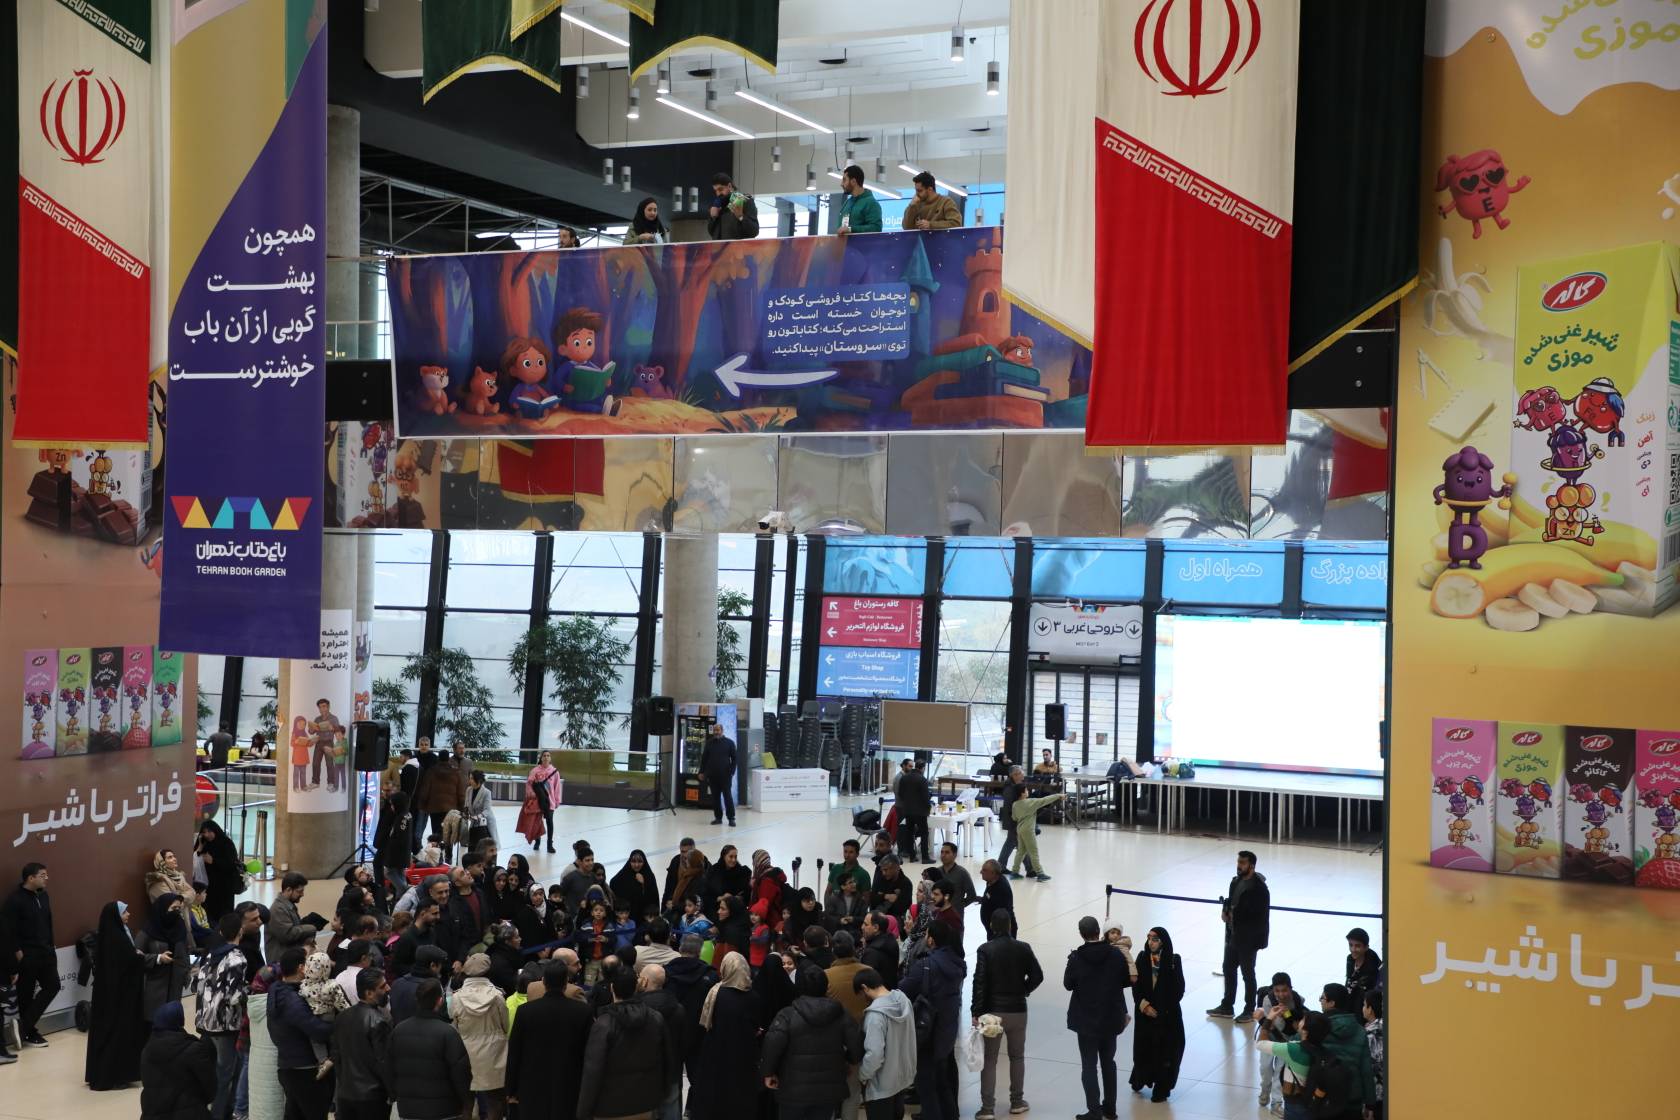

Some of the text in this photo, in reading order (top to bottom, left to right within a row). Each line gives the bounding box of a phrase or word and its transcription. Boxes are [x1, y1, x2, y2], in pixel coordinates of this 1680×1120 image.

[244, 224, 316, 256] همچون
[207, 266, 315, 294] بهشت
[775, 294, 805, 307] کودک
[805, 292, 841, 307] فروشی
[842, 291, 872, 306] کتاب
[1550, 276, 1598, 308] کاله
[767, 300, 774, 308] و
[767, 306, 907, 323] نوجوان خسته است داره
[184, 309, 220, 343] باب
[272, 305, 316, 344] گویی
[767, 330, 777, 338] رو
[859, 321, 906, 334] استراحت
[887, 340, 907, 352] توی
[1524, 323, 1619, 365] شیر غنی شده
[169, 354, 315, 388] خوشترست
[1547, 349, 1593, 372] موزی
[196, 540, 286, 563] باغ کتاب تهران
[196, 565, 228, 576] TEHRAN
[254, 566, 287, 577] GARDEN
[1179, 557, 1263, 582] همراه اول
[1310, 559, 1354, 585] بزرگ
[1063, 622, 1086, 634] غربی
[1087, 623, 1124, 636] خروجی
[13, 771, 182, 848] فراتر با شیر
[1419, 925, 1558, 993] شیر
[1570, 933, 1617, 1006] با
